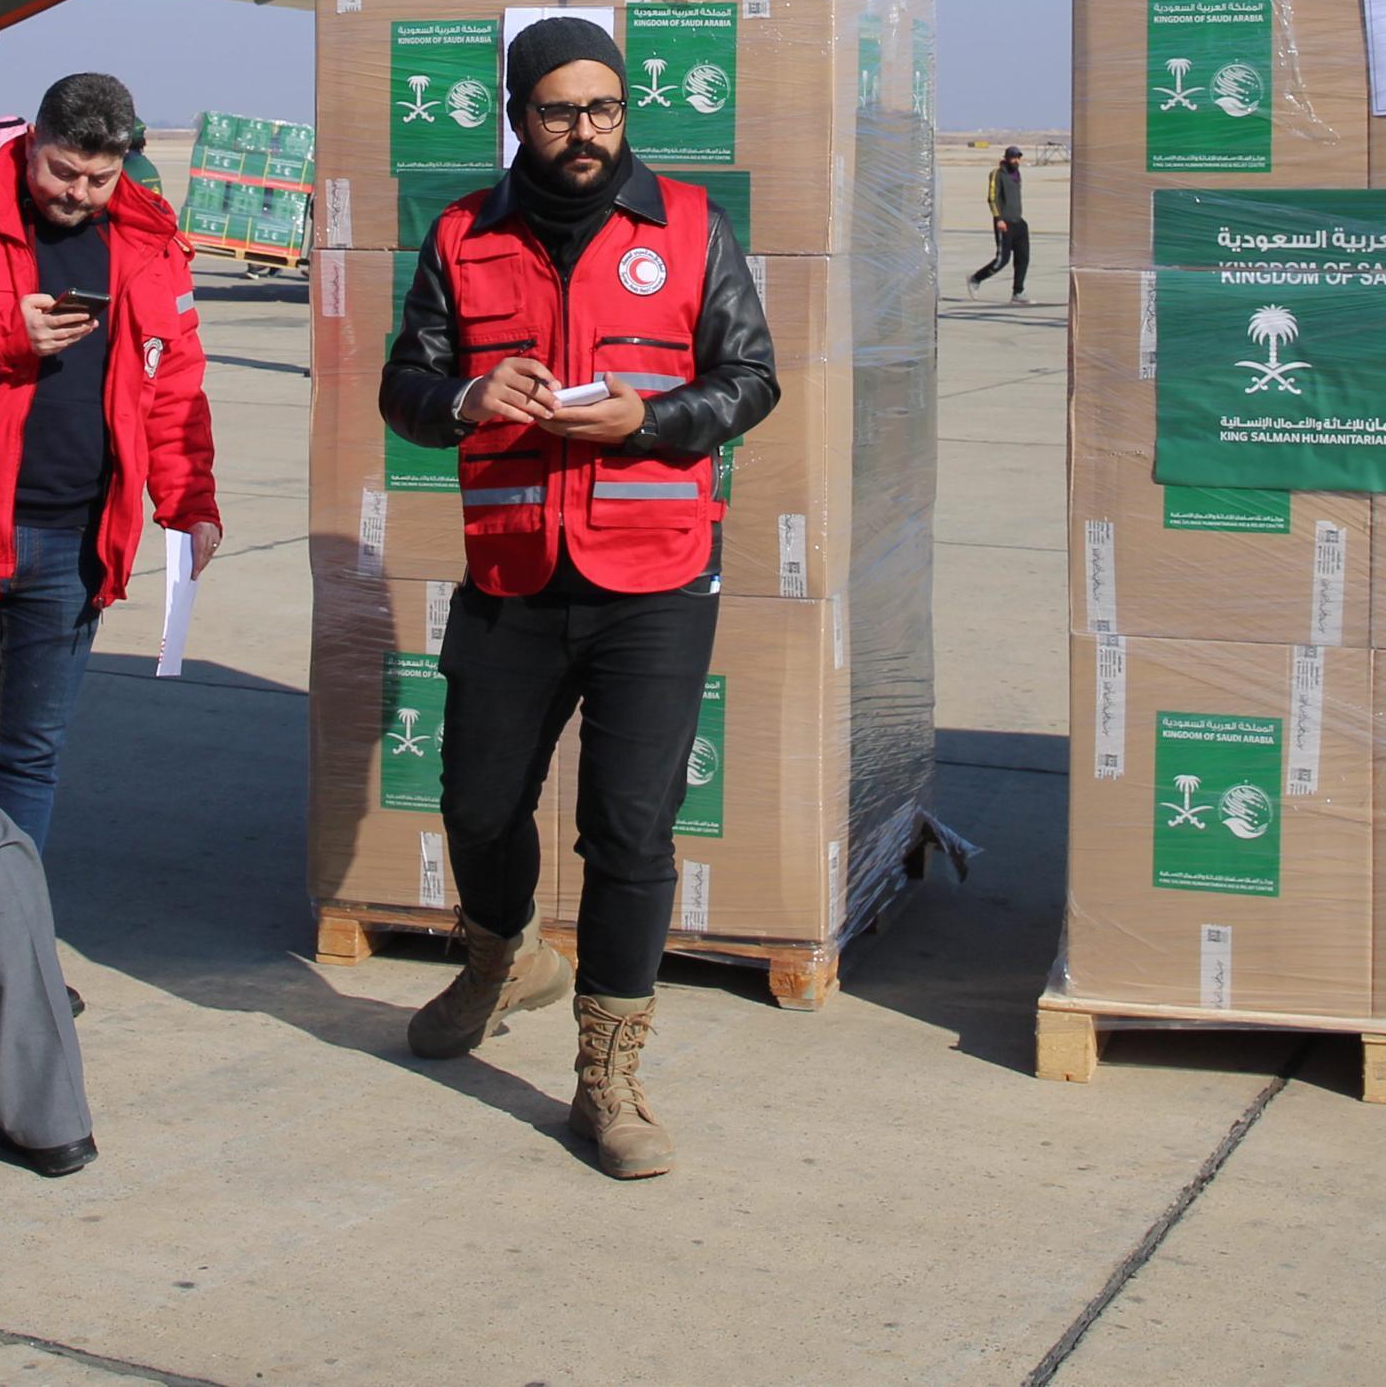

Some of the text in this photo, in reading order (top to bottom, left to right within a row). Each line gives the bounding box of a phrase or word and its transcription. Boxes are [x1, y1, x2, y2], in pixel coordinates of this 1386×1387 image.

[633, 19, 669, 27] KINGDOM
[681, 19, 703, 27] SAUDI
[704, 19, 732, 27] ARABIA
[1154, 15, 1193, 23] KINGDOM
[1194, 15, 1205, 23] OF
[1206, 15, 1231, 23] SAUDI
[443, 36, 465, 44] SAUDI
[1217, 227, 1327, 252] السعودية
[1219, 261, 1320, 285] KINGDOM
[1323, 262, 1354, 285] OF
[1220, 431, 1248, 442] KING
[1251, 432, 1300, 443] SALMAN
[1162, 730, 1274, 744] KINGDOM OF SAUDI ARABIA
